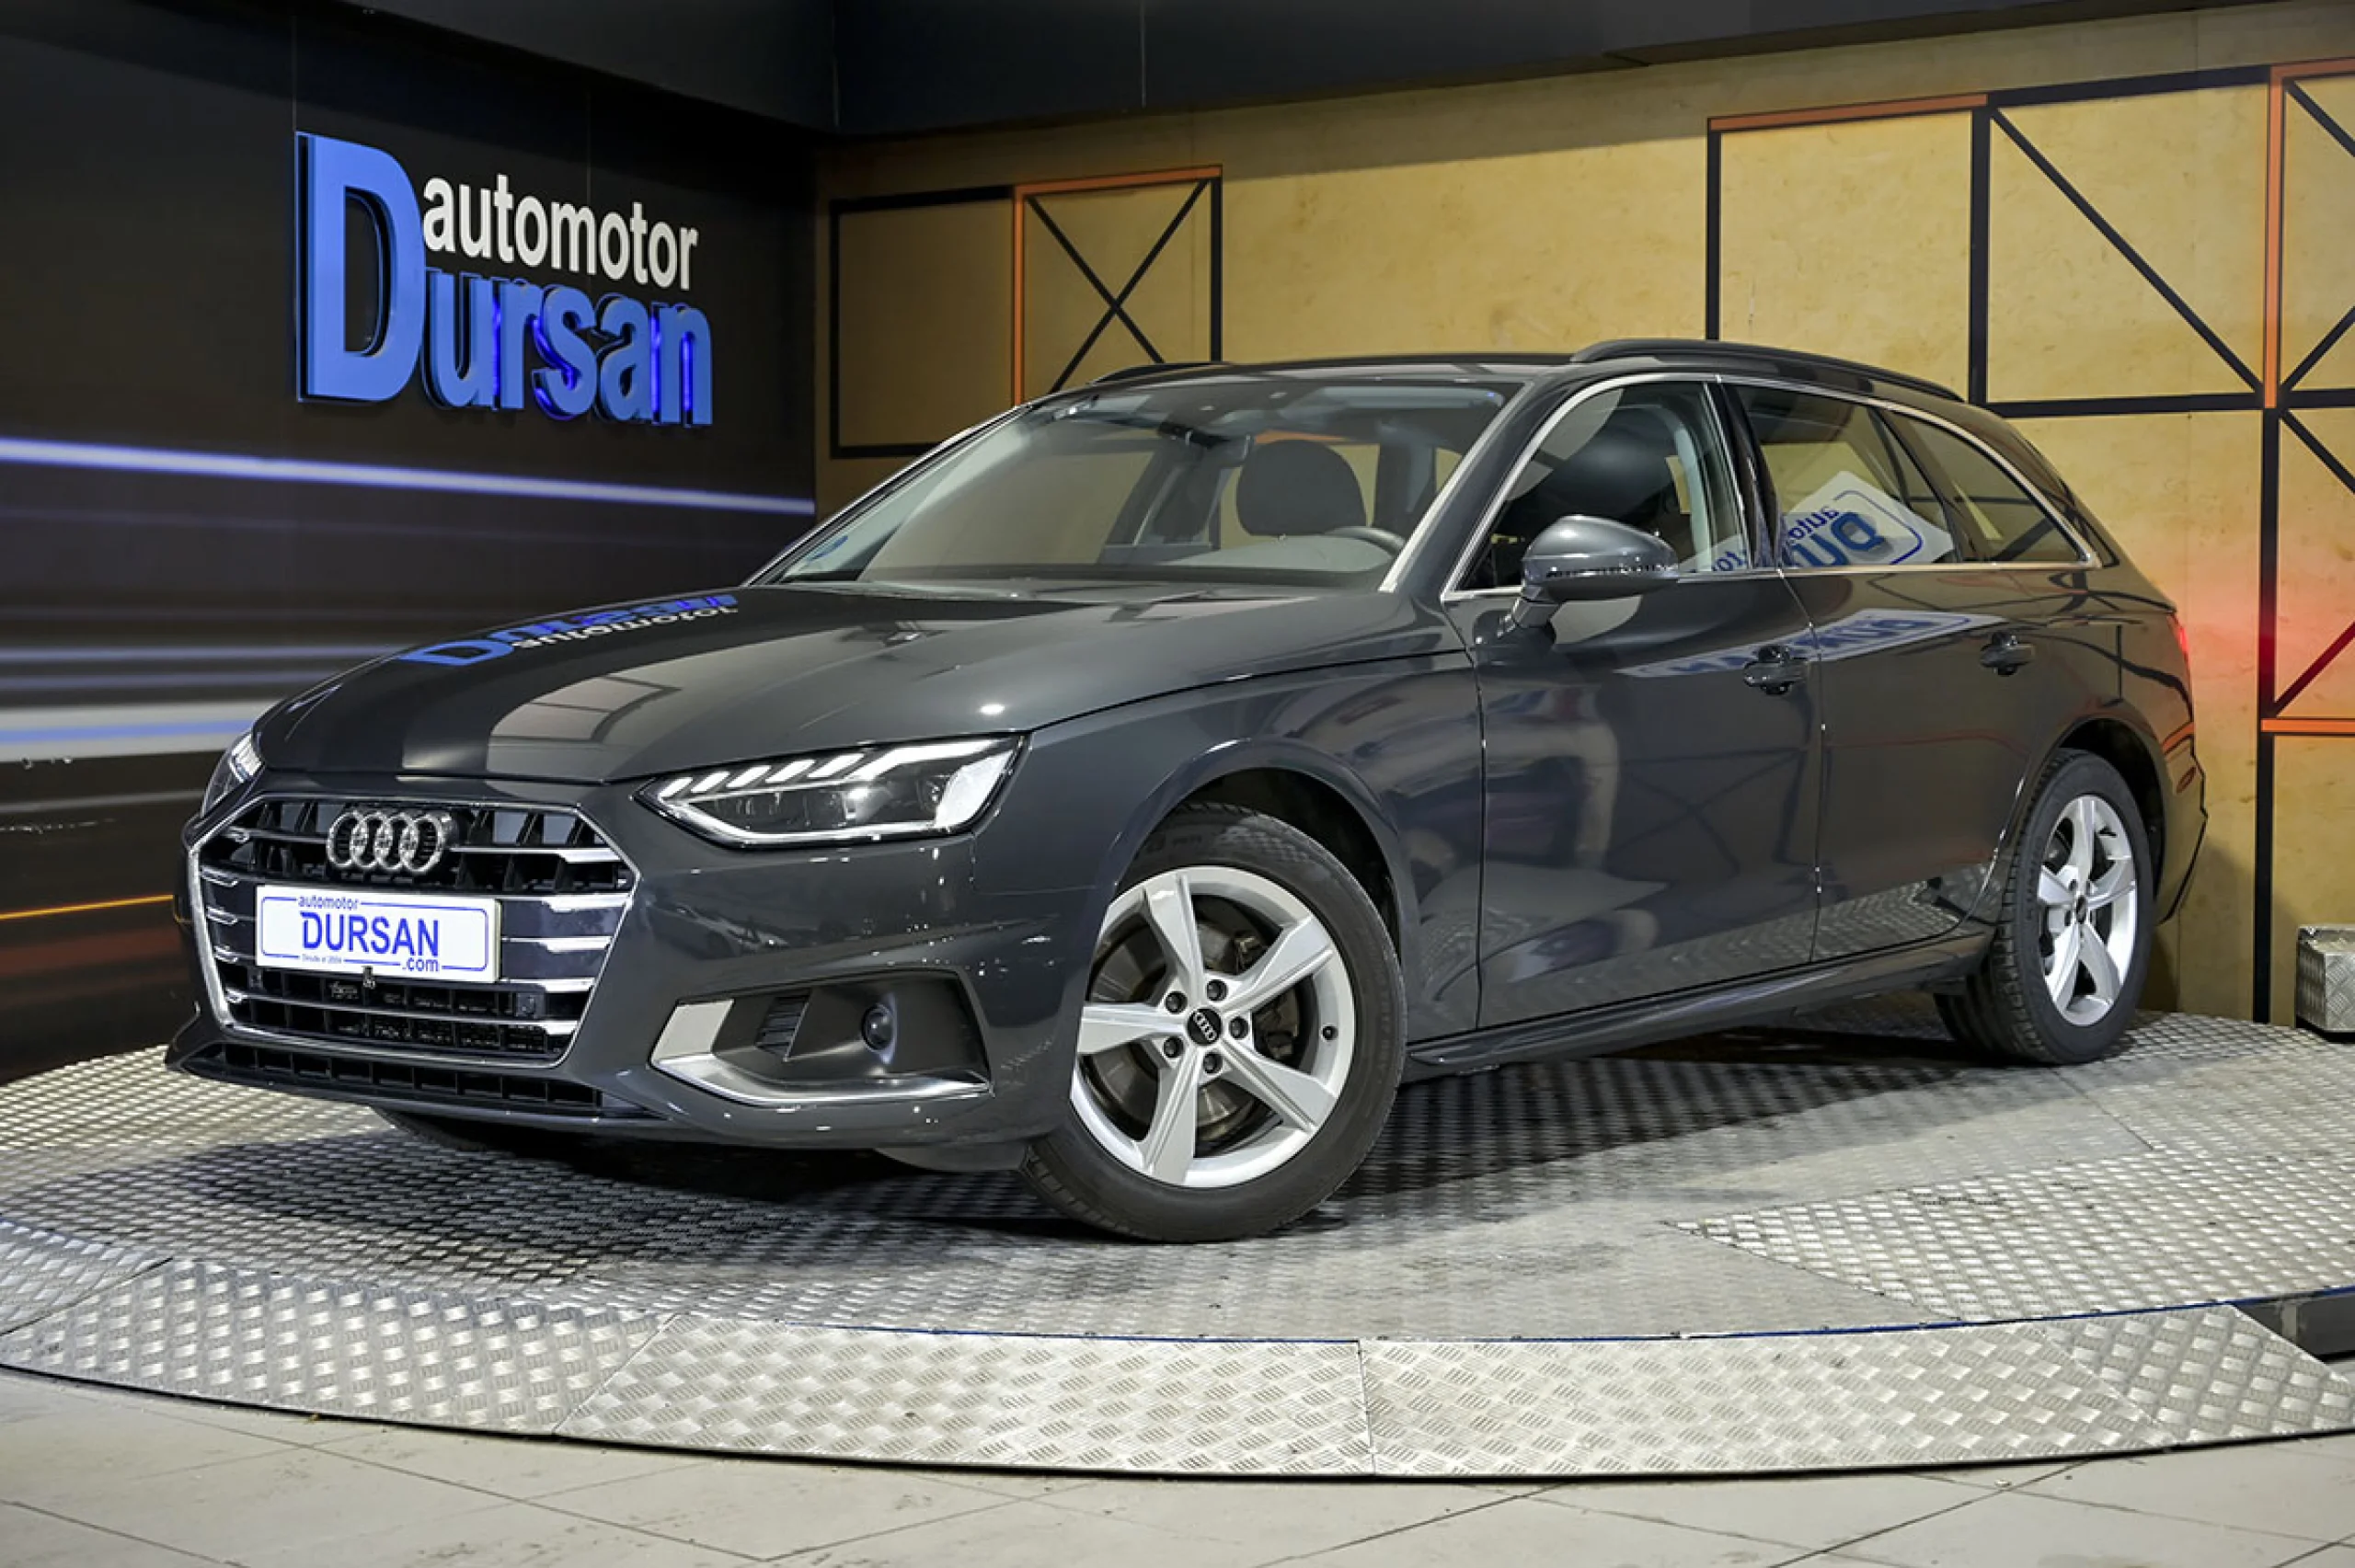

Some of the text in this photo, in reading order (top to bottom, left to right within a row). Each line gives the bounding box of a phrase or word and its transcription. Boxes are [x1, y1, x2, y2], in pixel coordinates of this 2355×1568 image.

[423, 174, 698, 291] automotor
[295, 132, 713, 427] Dursan
[298, 895, 360, 910] automotor
[300, 910, 439, 956] DURSAN
[402, 957, 439, 972] .com
